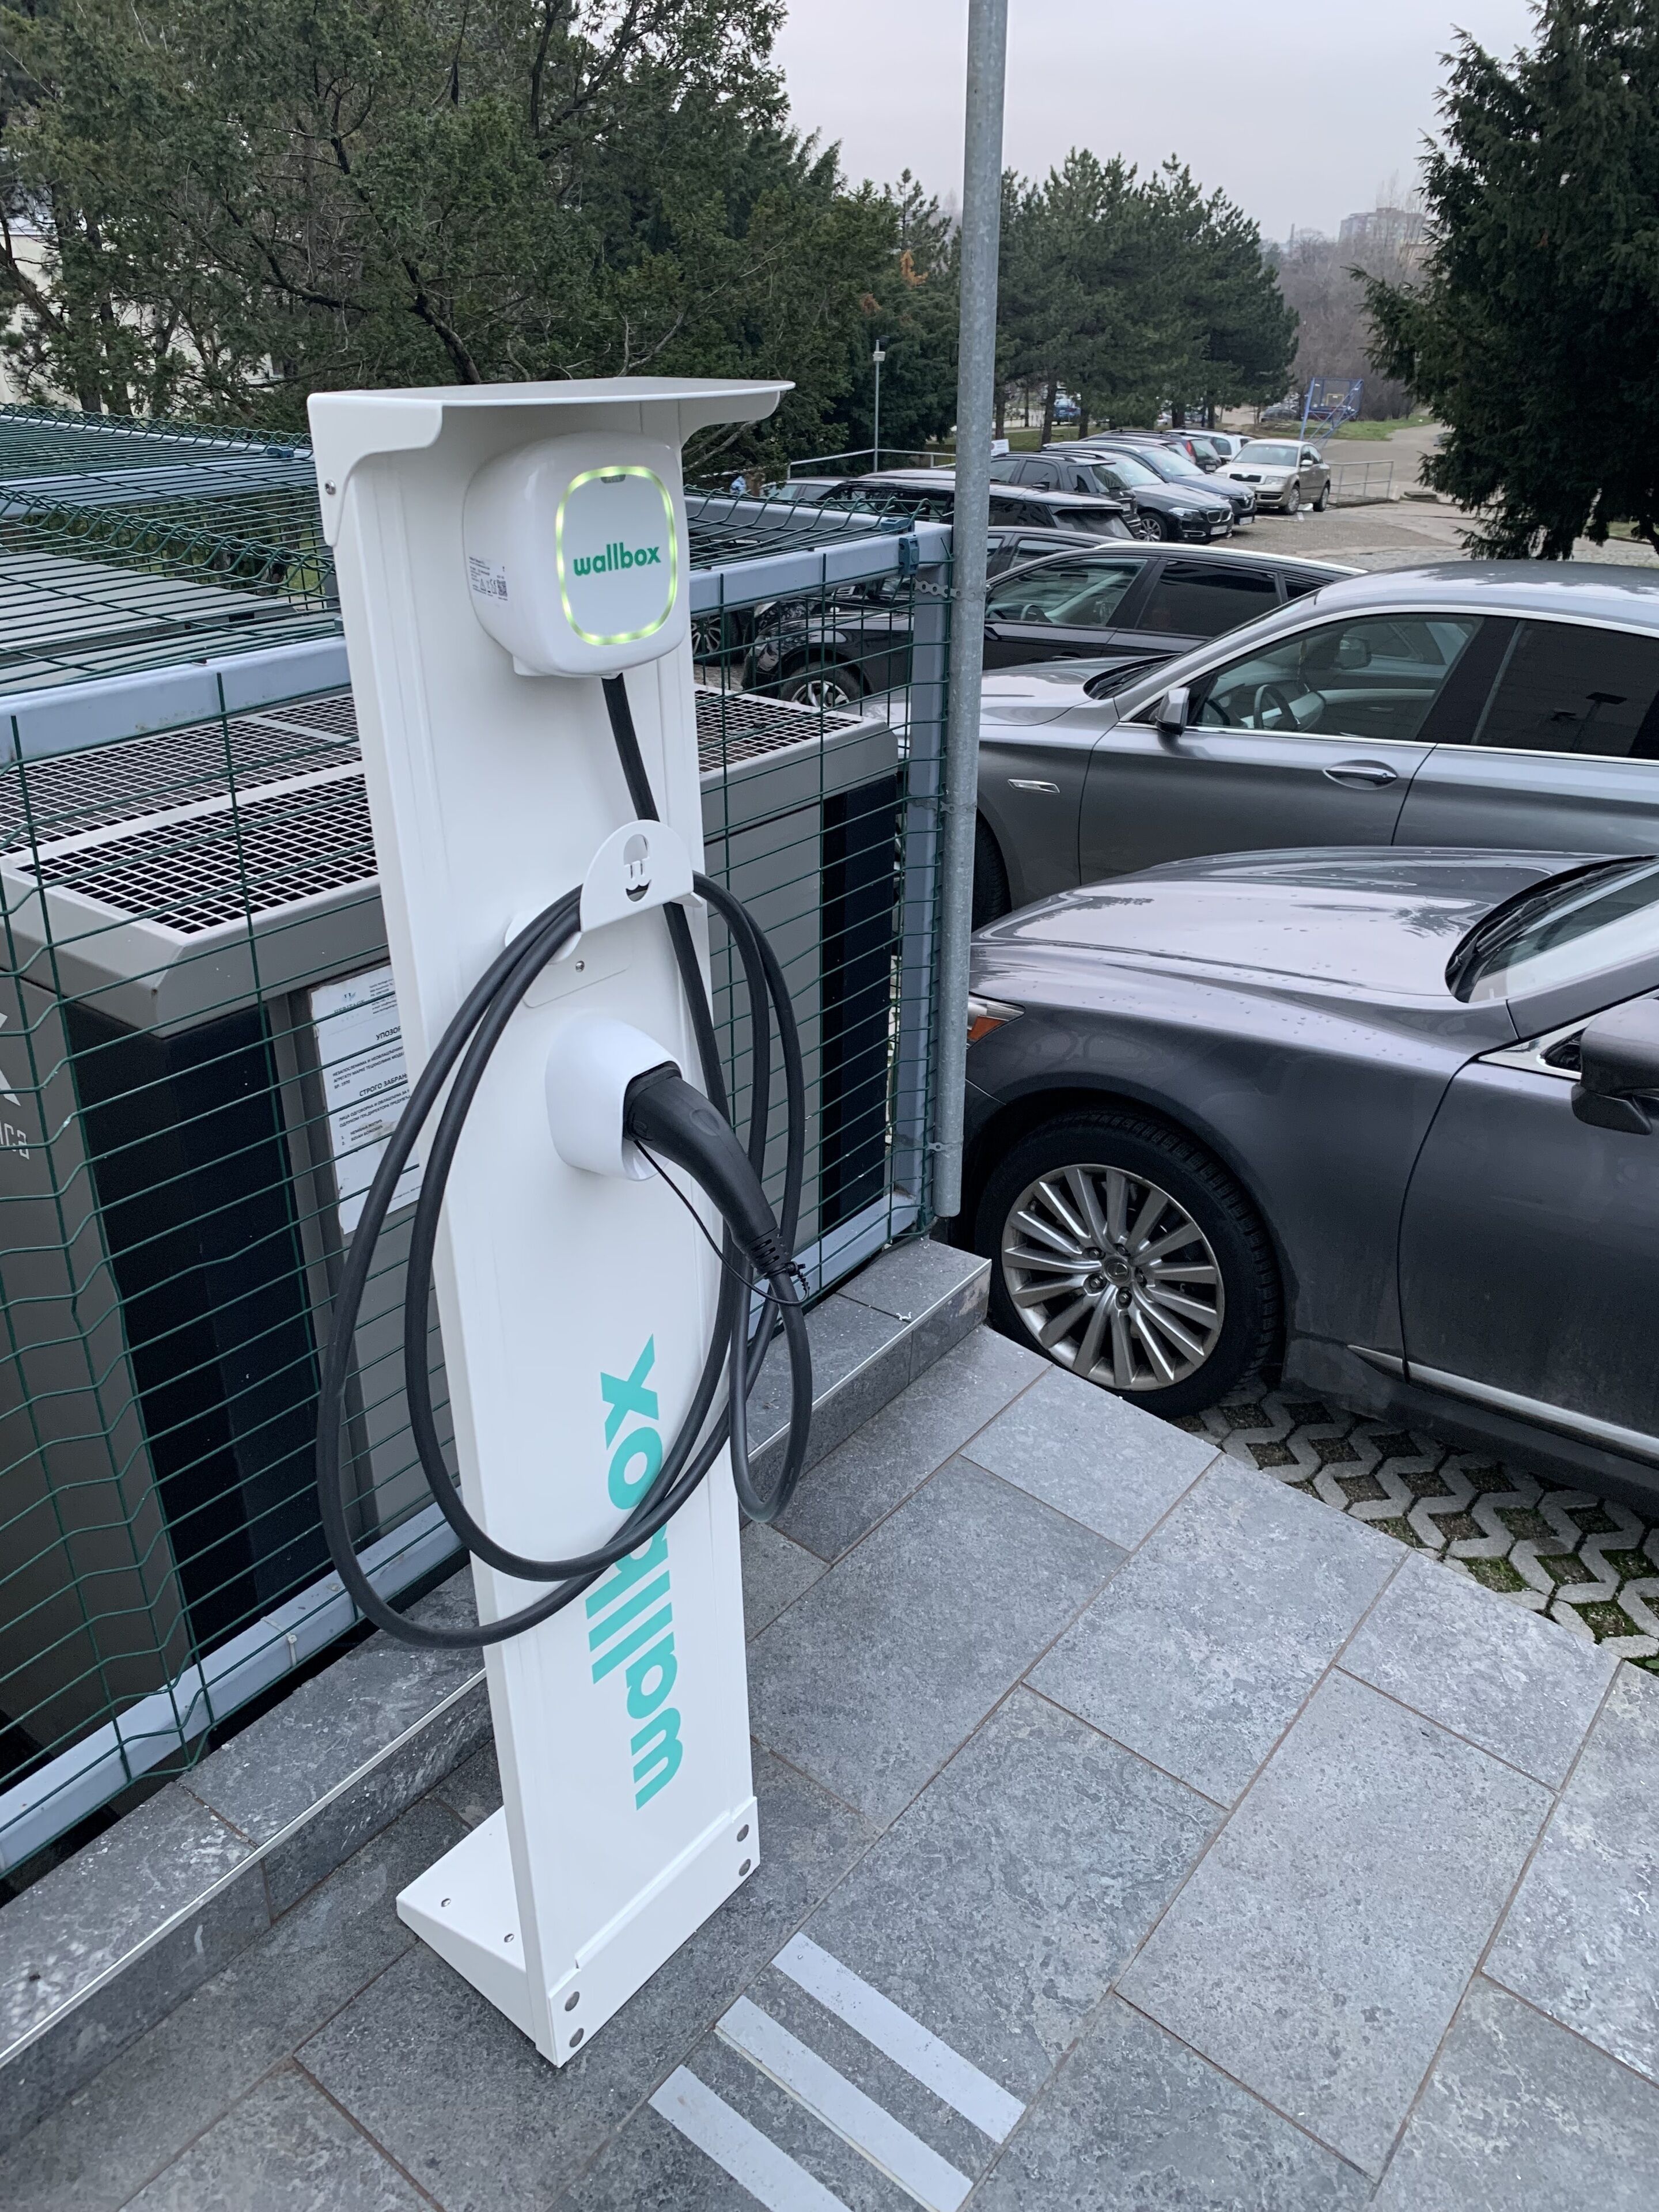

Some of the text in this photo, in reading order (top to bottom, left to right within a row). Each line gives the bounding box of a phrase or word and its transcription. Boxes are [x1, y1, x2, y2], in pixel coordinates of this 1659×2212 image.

[574, 542, 661, 576] wallbox
[359, 1083, 382, 1096] СТРОГО
[585, 1334, 683, 1810] wallbox
